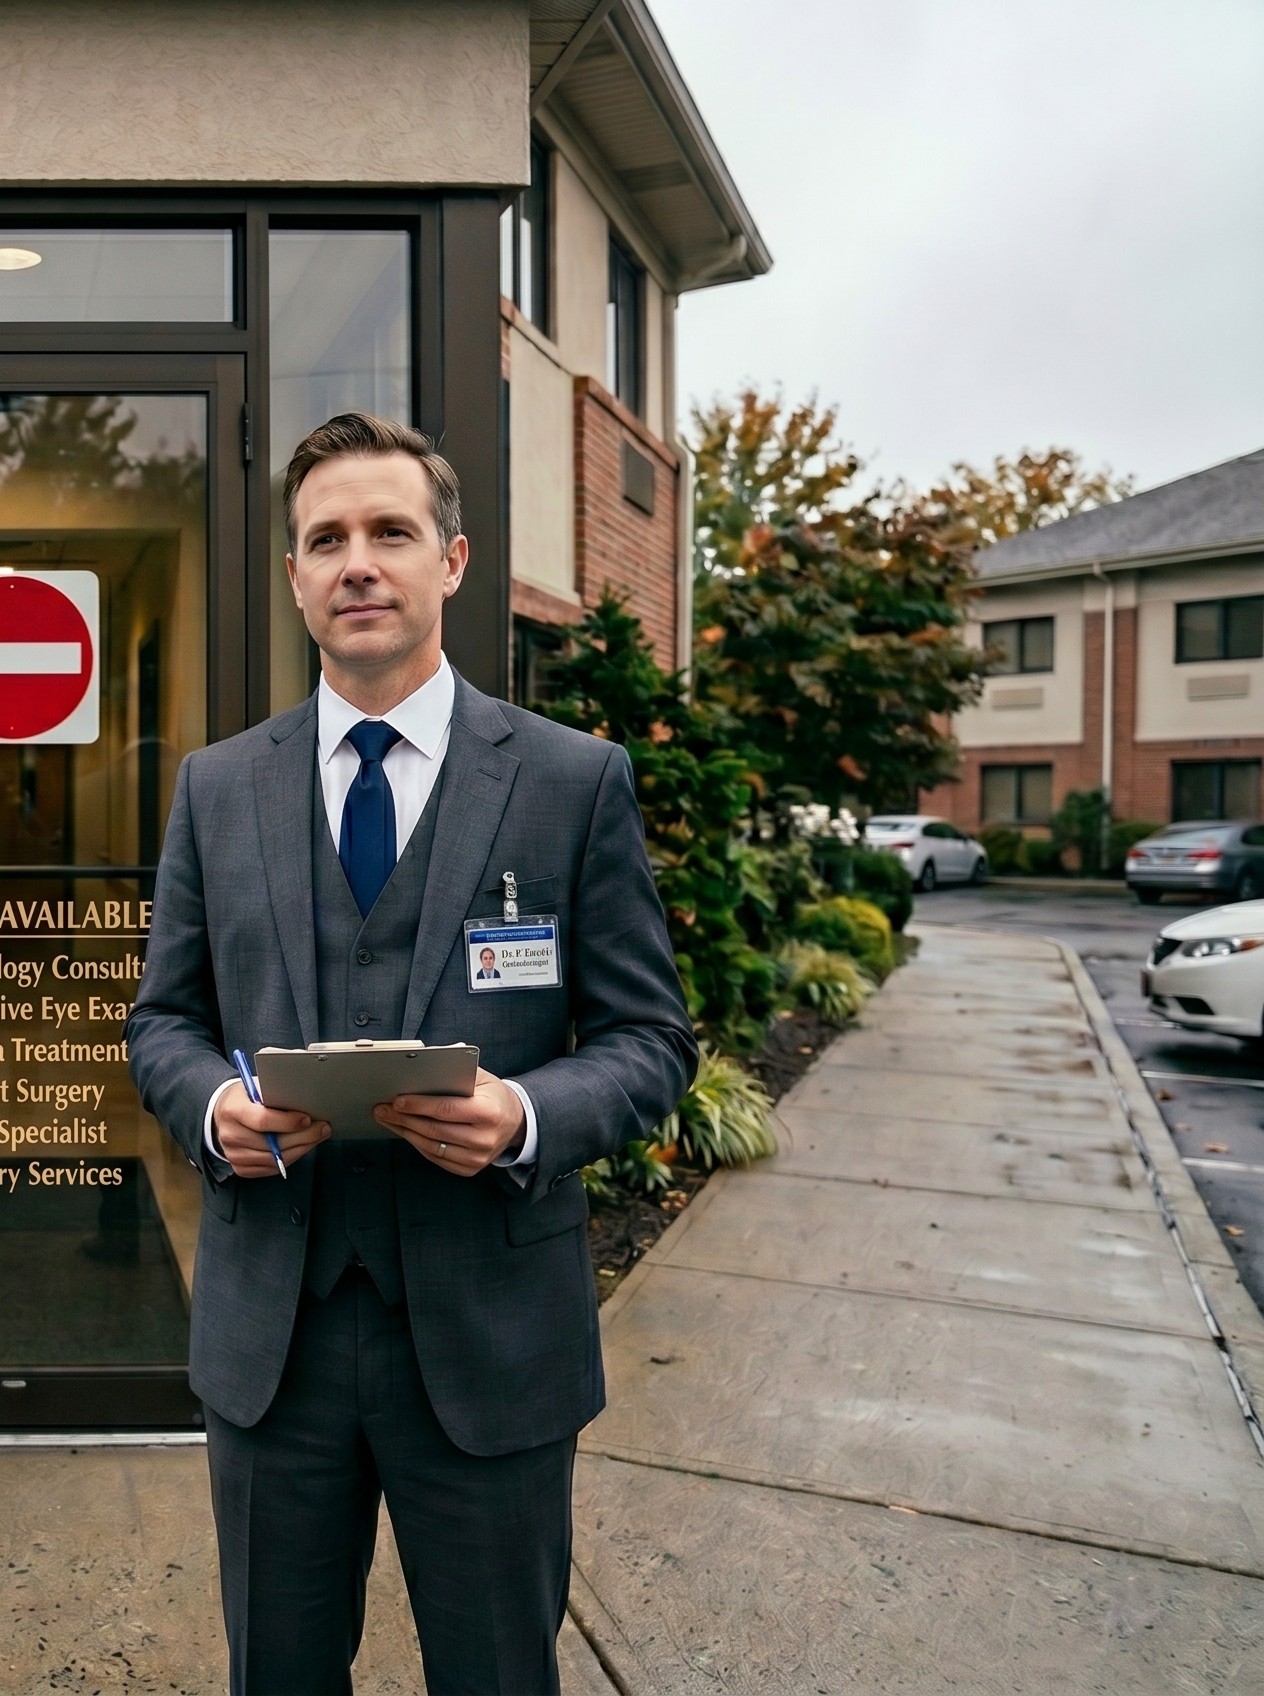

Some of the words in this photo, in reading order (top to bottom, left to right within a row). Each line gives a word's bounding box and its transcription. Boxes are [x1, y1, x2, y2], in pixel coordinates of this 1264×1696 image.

[51, 953, 146, 980] Consult
[41, 996, 81, 1029] Eye
[88, 996, 135, 1021] Exa
[10, 1037, 129, 1062] Treatment
[16, 1078, 106, 1111] Surgery
[28, 1160, 123, 1186] Services
